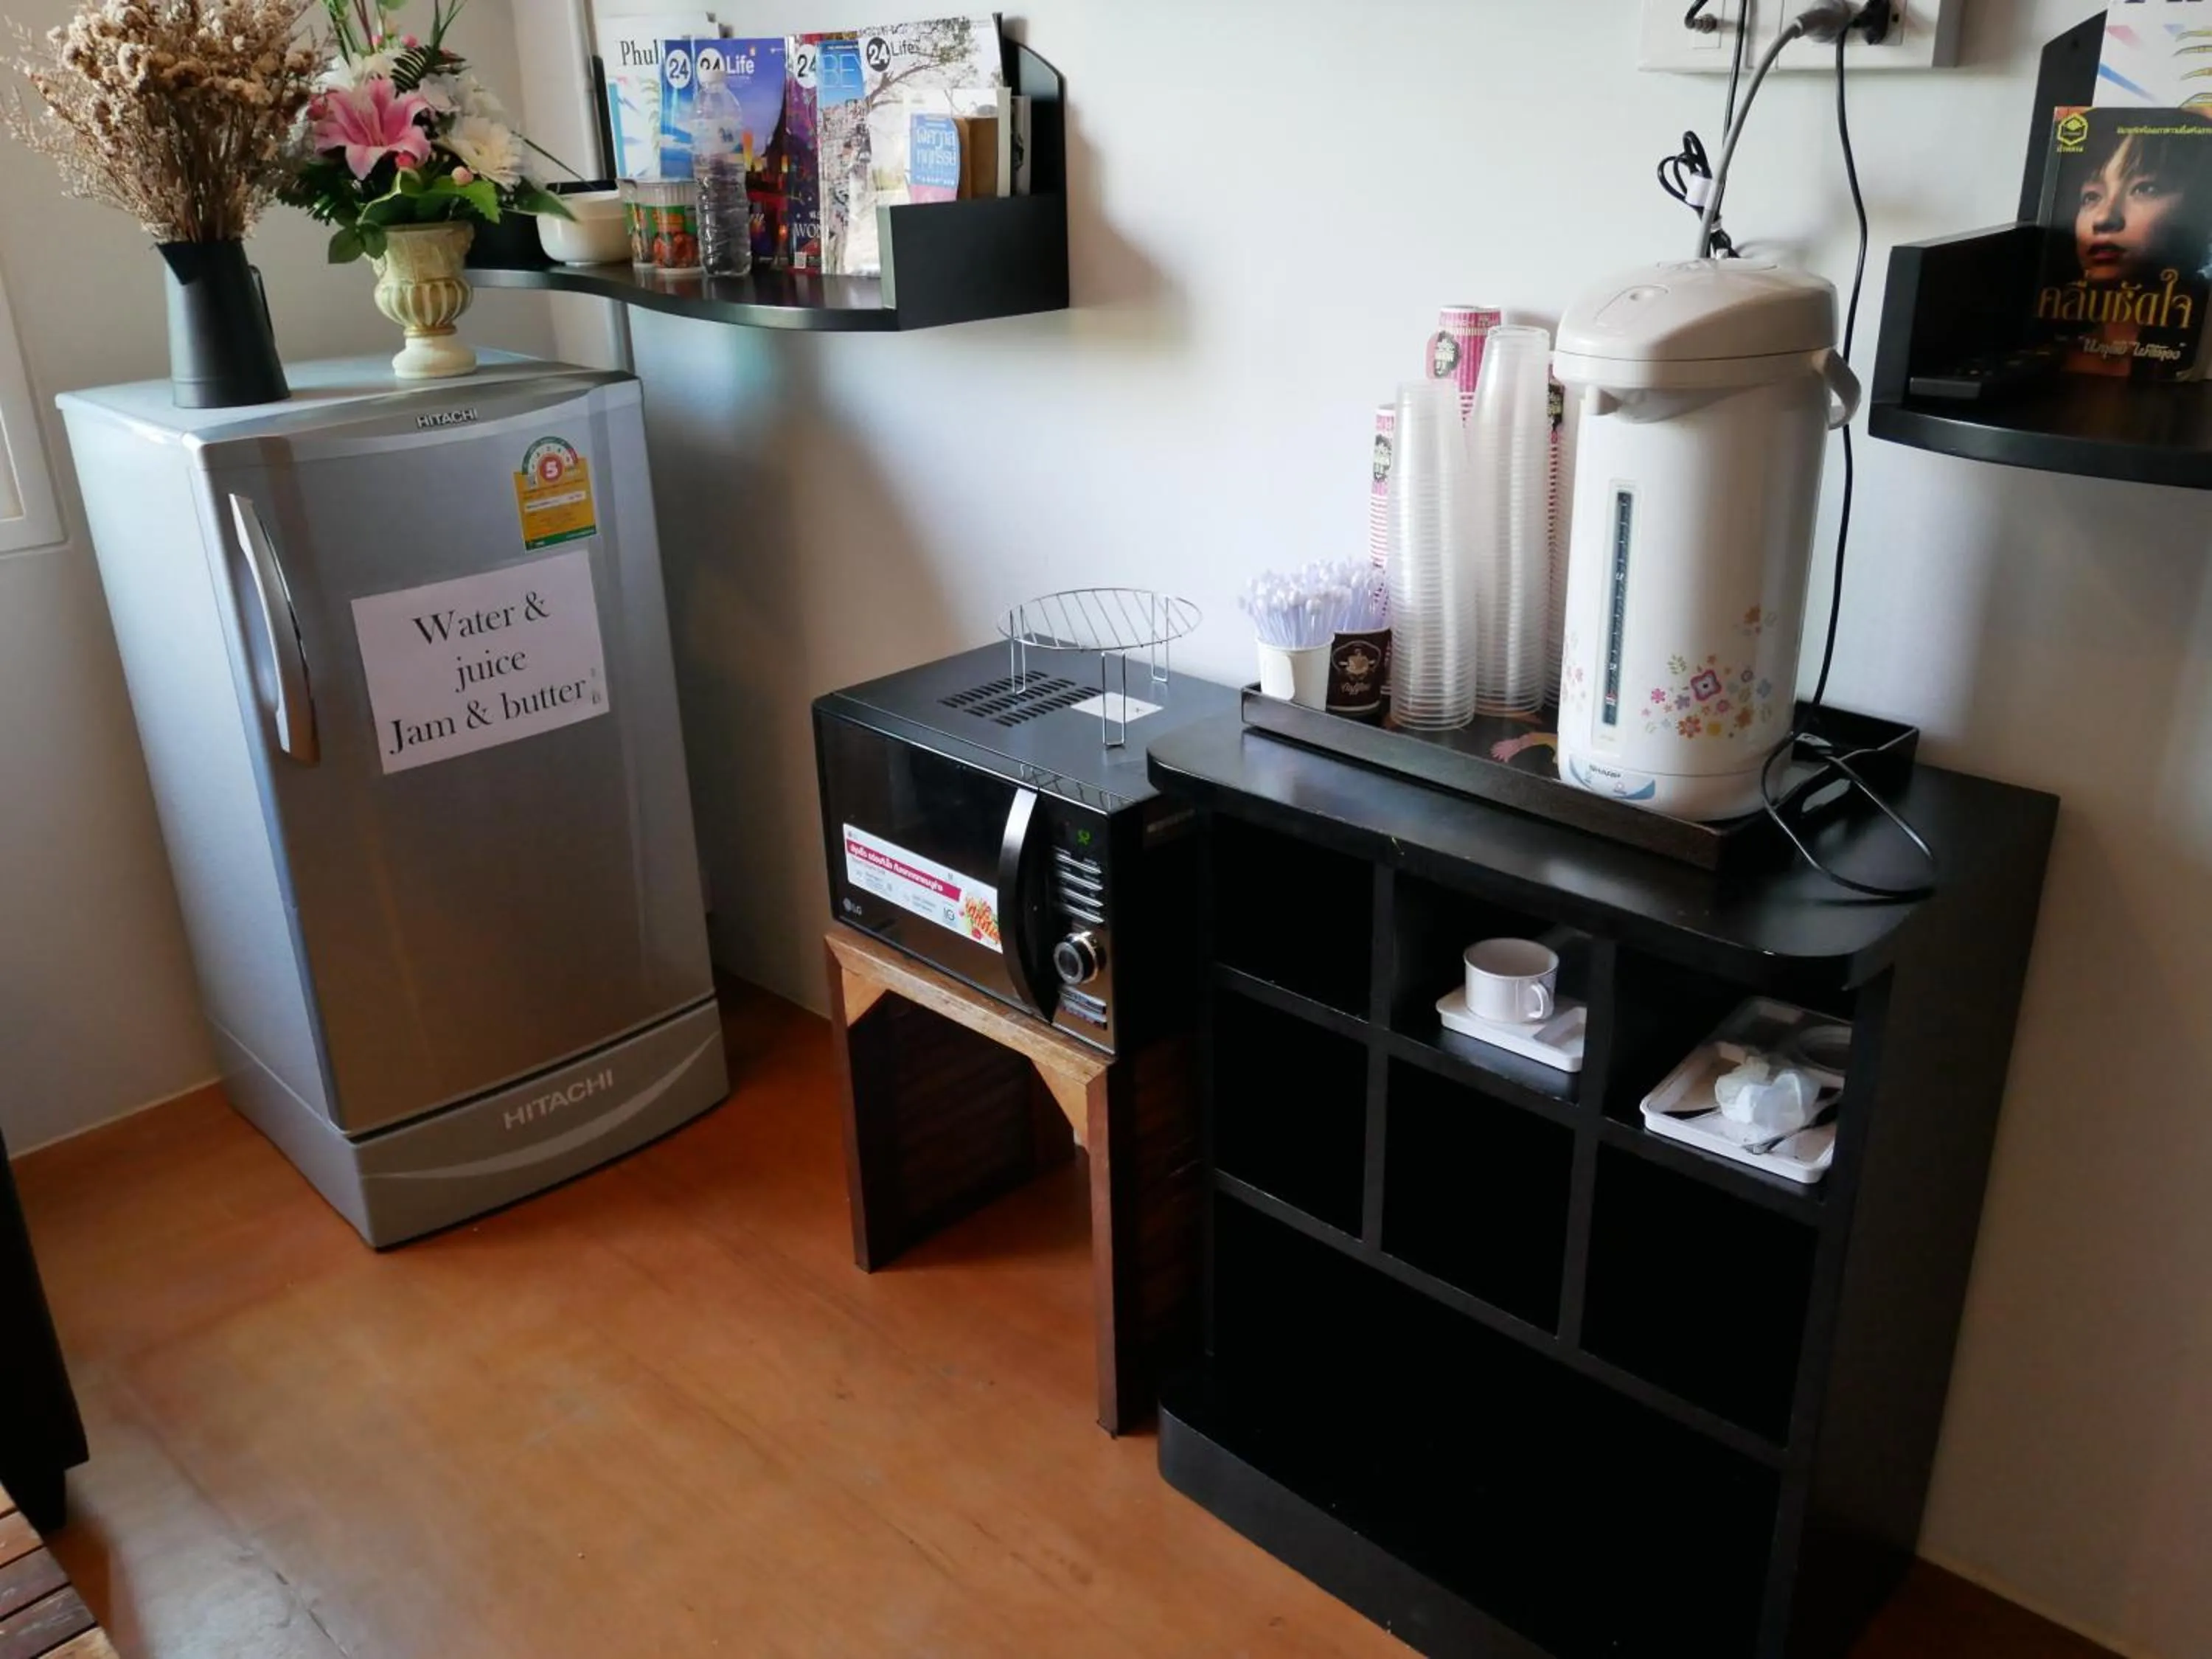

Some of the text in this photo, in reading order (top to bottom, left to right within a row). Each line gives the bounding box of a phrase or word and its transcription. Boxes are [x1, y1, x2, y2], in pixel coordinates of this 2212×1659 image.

[669, 58, 689, 80] 24
[726, 55, 755, 74] Life
[869, 40, 916, 65] 24 Life
[415, 408, 478, 428] HITACHI
[412, 591, 550, 646] Water &
[455, 650, 526, 693] juice
[389, 678, 587, 754] Jam & butter
[504, 1069, 614, 1130] HITACHI
